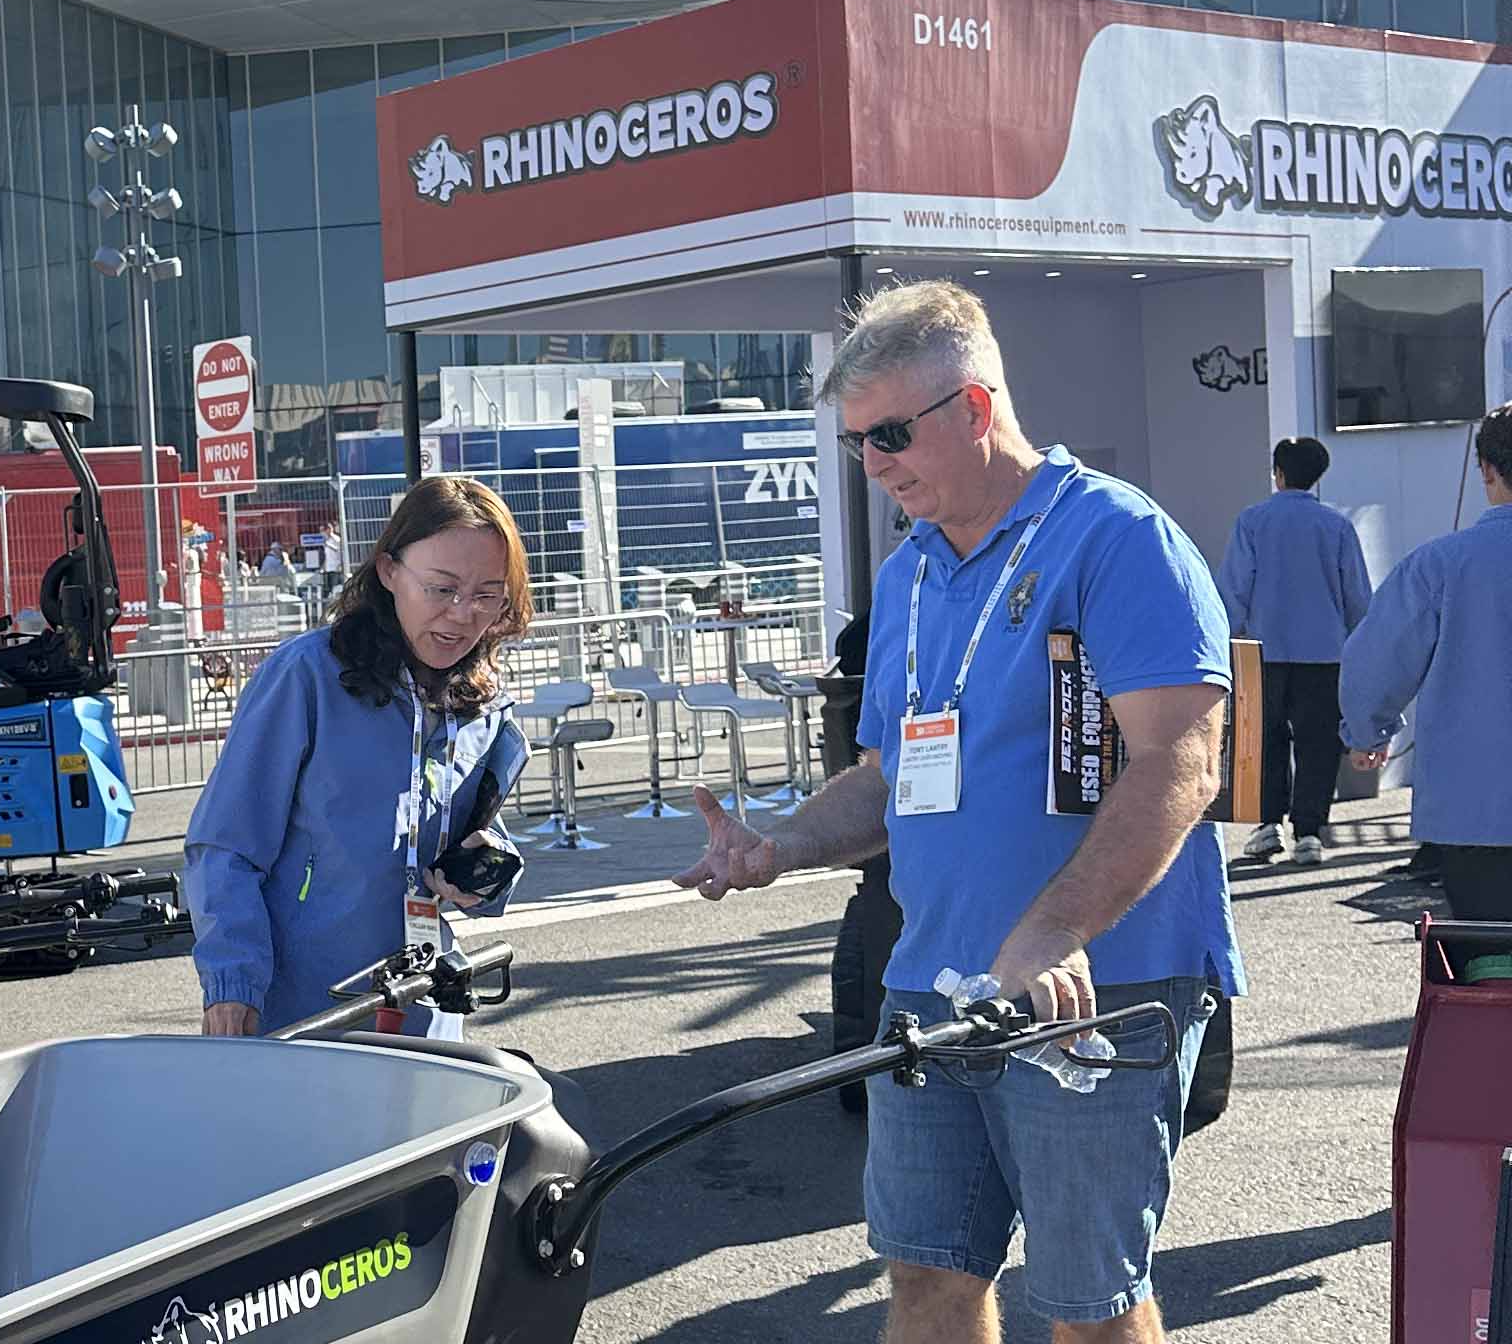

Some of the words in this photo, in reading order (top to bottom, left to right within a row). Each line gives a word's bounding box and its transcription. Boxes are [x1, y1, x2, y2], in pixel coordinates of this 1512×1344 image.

[913, 13, 993, 51] D1461
[482, 72, 777, 189] RHINOCEROS
[202, 362, 217, 377] DO
[222, 356, 242, 373] NOT
[208, 401, 240, 420] ENTER
[204, 441, 249, 464] WRONG
[213, 465, 241, 483] WAY
[1059, 669, 1075, 774] BEDROCK
[1080, 754, 1101, 804] USED
[223, 1230, 413, 1341] RHINOCEROS
